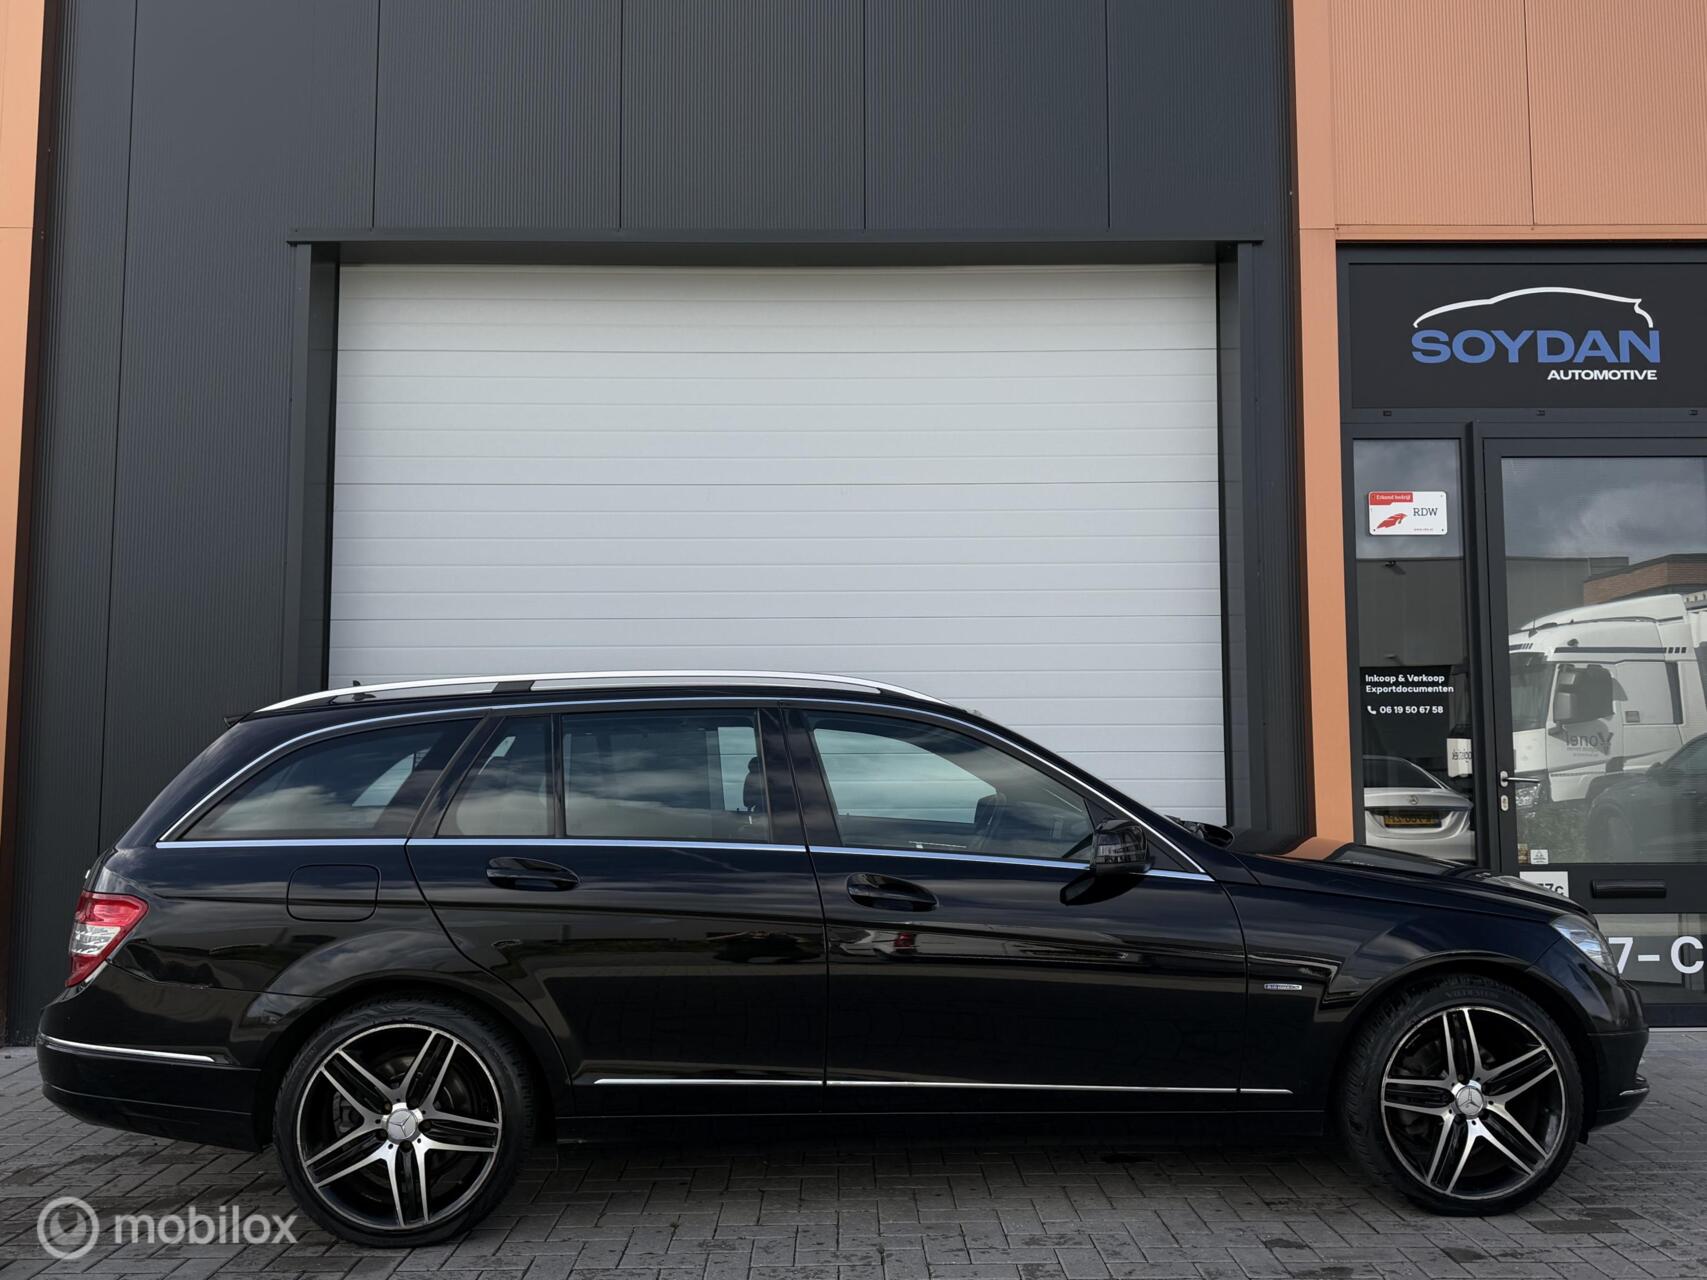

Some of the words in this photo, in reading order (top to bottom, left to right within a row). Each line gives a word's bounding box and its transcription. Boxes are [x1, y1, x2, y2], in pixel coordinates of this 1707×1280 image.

[1411, 329, 1661, 364] SOYDAN
[1547, 369, 1657, 380] AUTOMOTIVE
[1413, 507, 1438, 517] RDW
[1365, 674, 1396, 684] Inkoop
[1398, 674, 1405, 682] &
[1407, 674, 1445, 683] Verkoop
[1366, 685, 1454, 694] Exportdocumenten
[1380, 705, 1392, 714] 06
[1394, 705, 1403, 714] 19
[1405, 705, 1417, 714] 50
[1419, 705, 1430, 714] 67
[1432, 705, 1444, 714] 58
